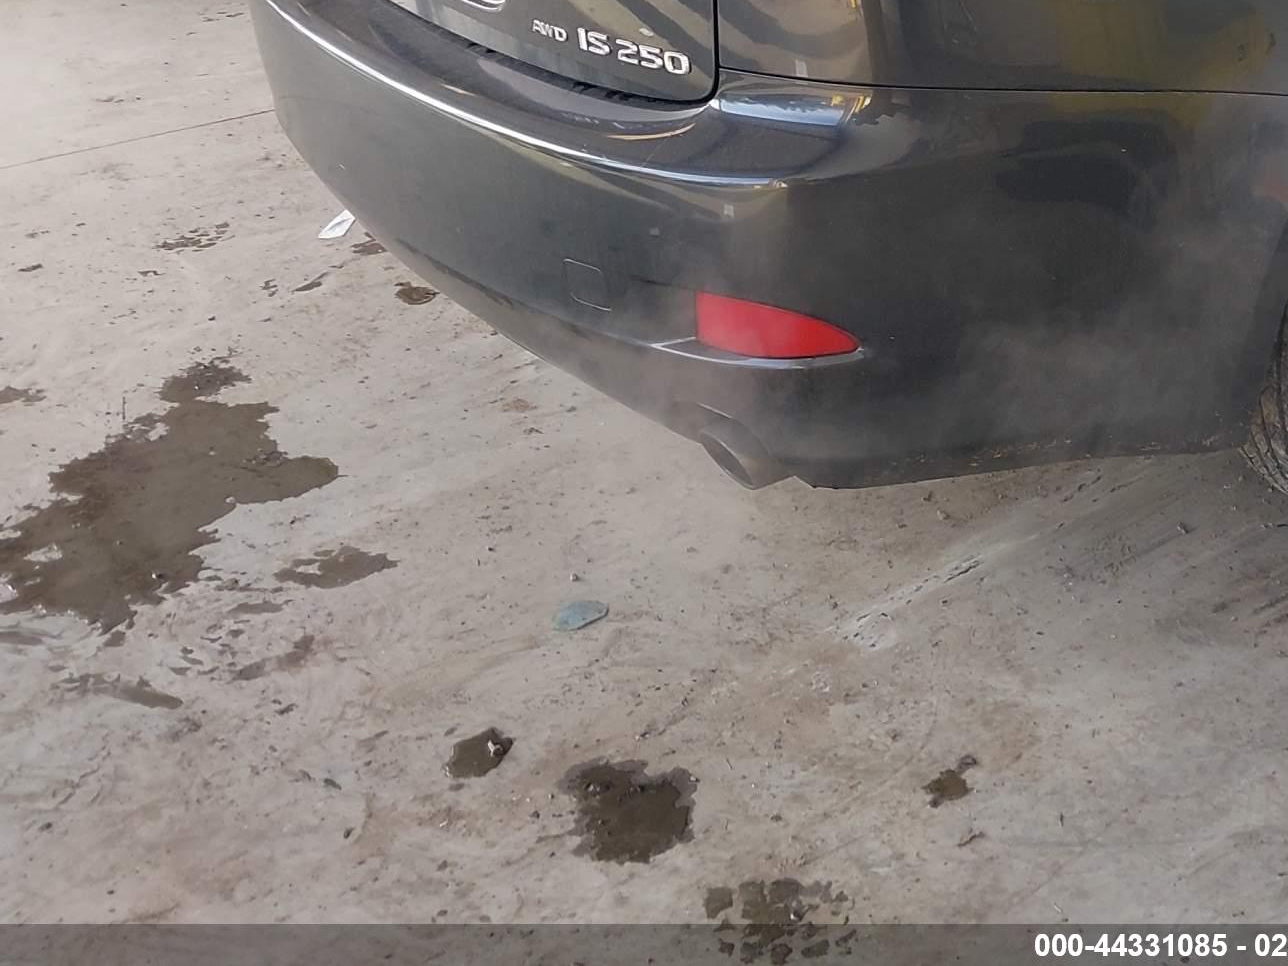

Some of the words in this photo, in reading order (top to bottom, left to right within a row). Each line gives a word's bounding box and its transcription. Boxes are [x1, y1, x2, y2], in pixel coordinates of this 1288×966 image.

[531, 19, 568, 43] AWD
[577, 27, 612, 56] IS
[615, 38, 692, 75] 250
